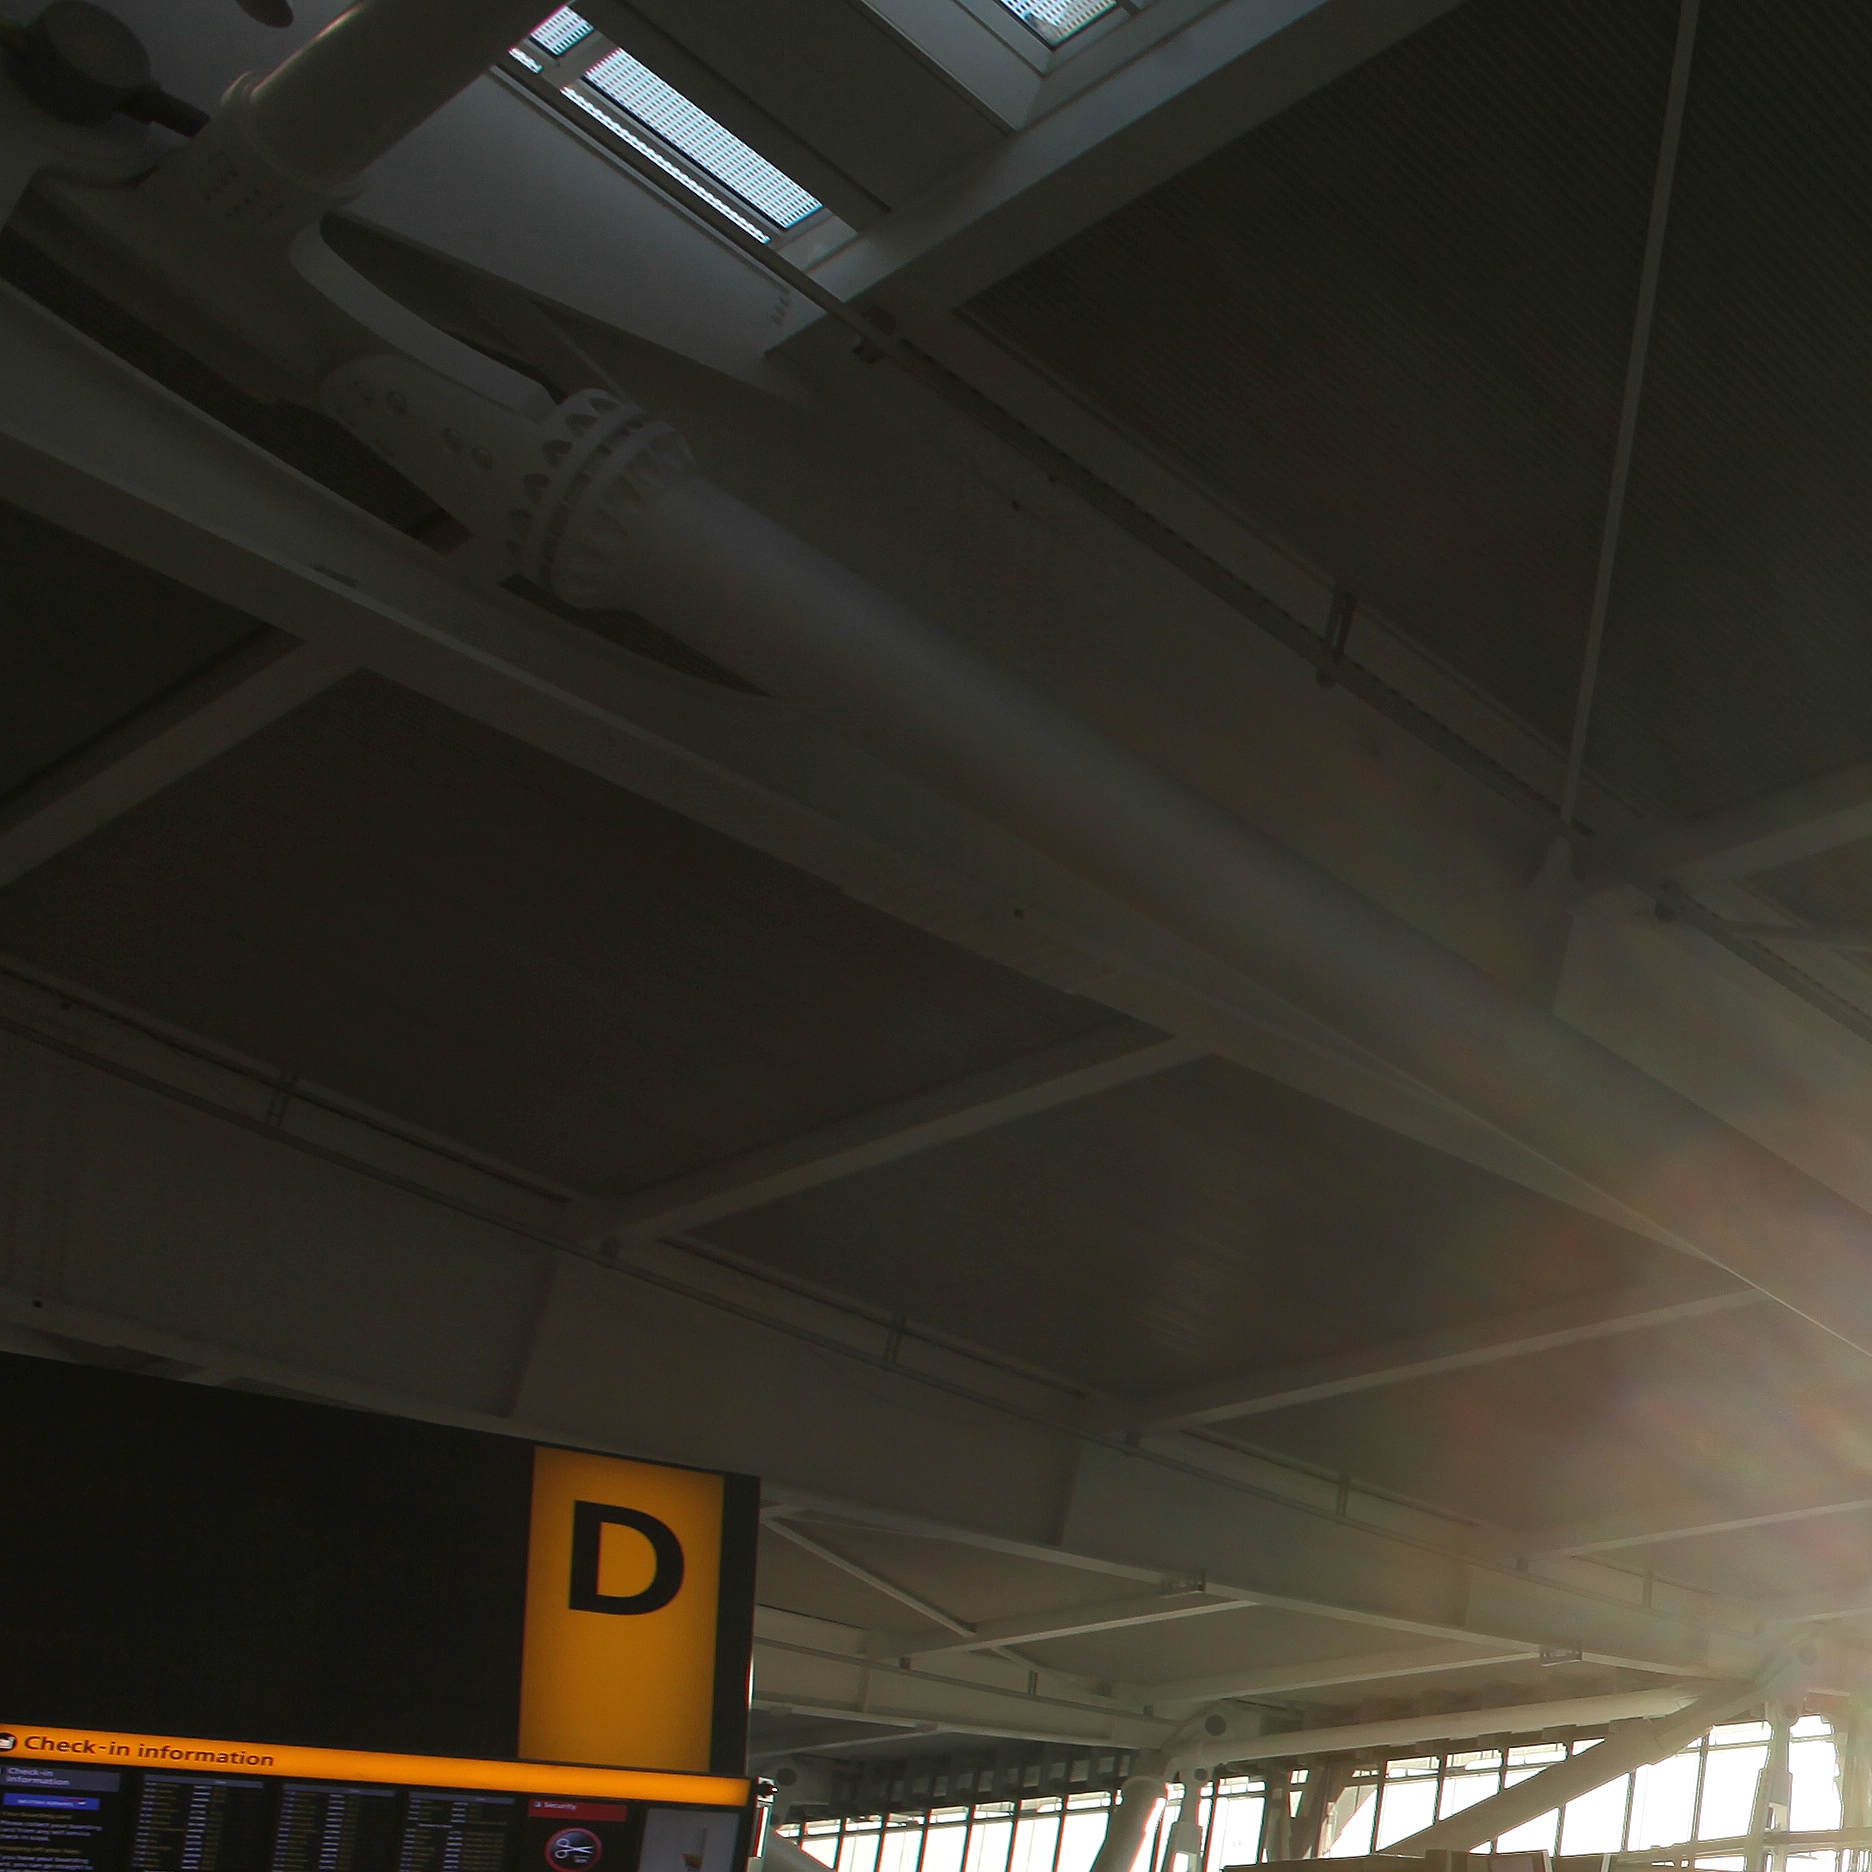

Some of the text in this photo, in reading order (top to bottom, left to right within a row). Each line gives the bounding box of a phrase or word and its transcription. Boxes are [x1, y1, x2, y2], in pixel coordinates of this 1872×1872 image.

[568, 1500, 686, 1616] D
[25, 1734, 275, 1768] Check-in information
